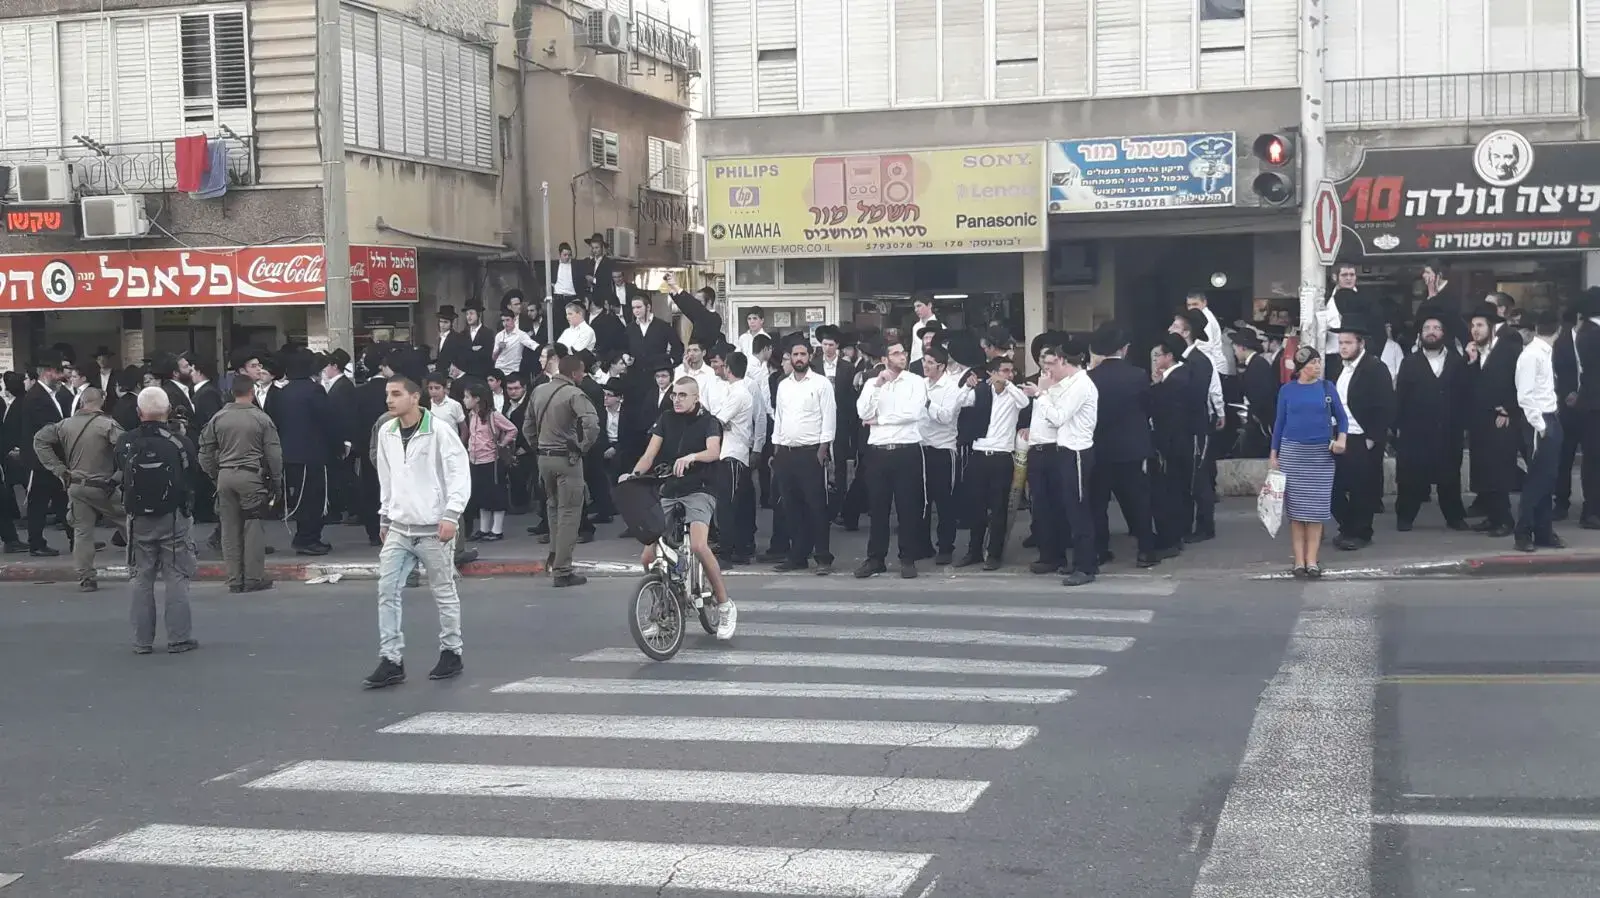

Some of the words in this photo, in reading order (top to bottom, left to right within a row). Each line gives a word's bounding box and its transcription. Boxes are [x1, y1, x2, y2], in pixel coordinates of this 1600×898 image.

[1078, 143, 1118, 162] מור
[1122, 138, 1188, 161] חשמל
[963, 154, 1031, 168] SONY
[715, 165, 779, 178] PHILIPS
[1087, 168, 1120, 177] מנעולים
[1124, 166, 1157, 175] והחלפת
[1161, 165, 1183, 175] תיקון
[1082, 179, 1124, 187] המפתחות
[1128, 177, 1145, 185] סוגי
[1148, 175, 1158, 183] כל
[1161, 174, 1189, 183] שכפול
[971, 184, 1037, 199] Leno
[1129, 186, 1150, 195] אדיב
[1154, 185, 1177, 194] שרות
[1095, 198, 1166, 210] 03-5793078
[1342, 176, 1404, 223] 10
[1405, 183, 1506, 216] גולדה
[1516, 185, 1600, 213] פיצה
[809, 205, 848, 226] מור
[857, 200, 920, 225] חשמל
[956, 212, 1038, 228] Panasonic
[728, 222, 782, 239] YAMAHA
[804, 227, 868, 241] ומחשבים
[873, 225, 928, 239] סטריאו
[865, 241, 913, 251] 5793078
[1435, 232, 1513, 249] היסטוריה
[1517, 231, 1573, 246] עושים
[741, 244, 832, 254] WWW.E-MOR.CO.IL
[370, 250, 387, 269] הלל
[391, 251, 415, 269] פלאפל
[98, 252, 234, 298] פלאפל
[248, 254, 325, 284] Coca-Cola
[51, 268, 67, 295] 6
[77, 272, 96, 282] מנה
[393, 276, 400, 292] 6
[0, 270, 35, 302] ה
